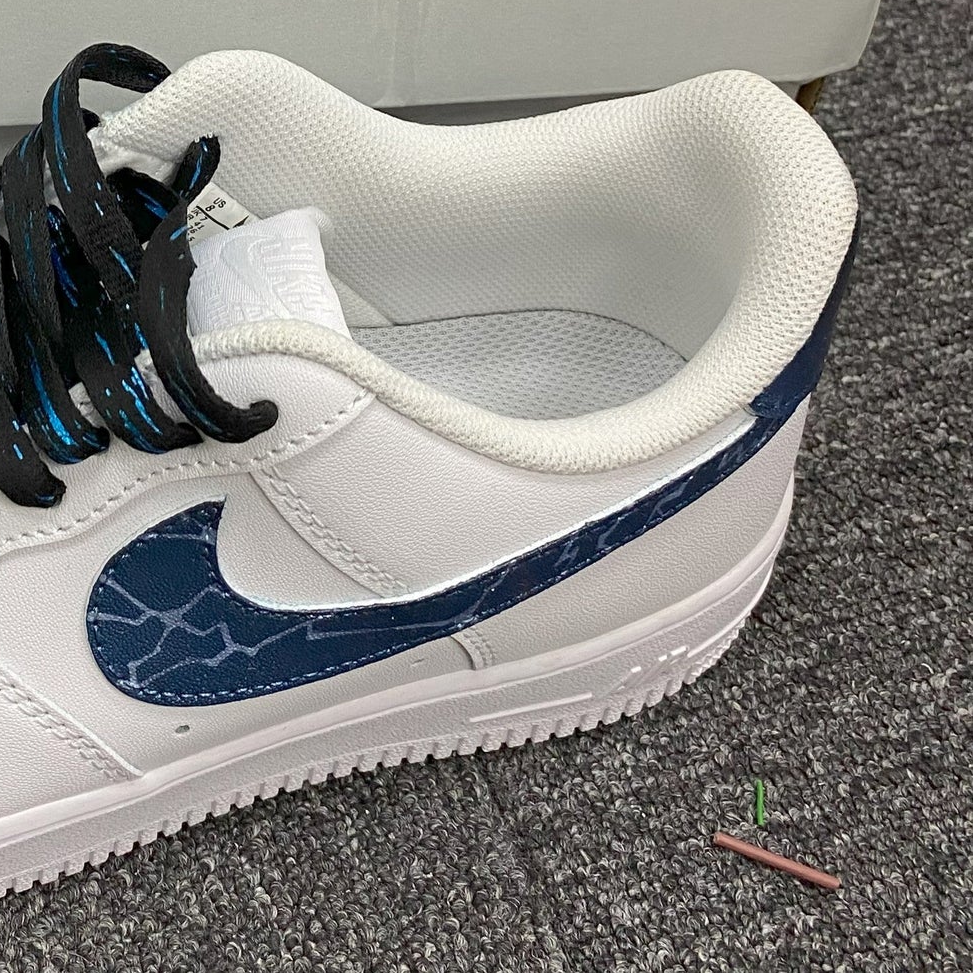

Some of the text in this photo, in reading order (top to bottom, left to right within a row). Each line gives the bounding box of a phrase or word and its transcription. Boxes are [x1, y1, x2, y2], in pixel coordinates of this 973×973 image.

[213, 197, 227, 209] US
[205, 204, 216, 212] 8
[194, 222, 205, 230] 41
